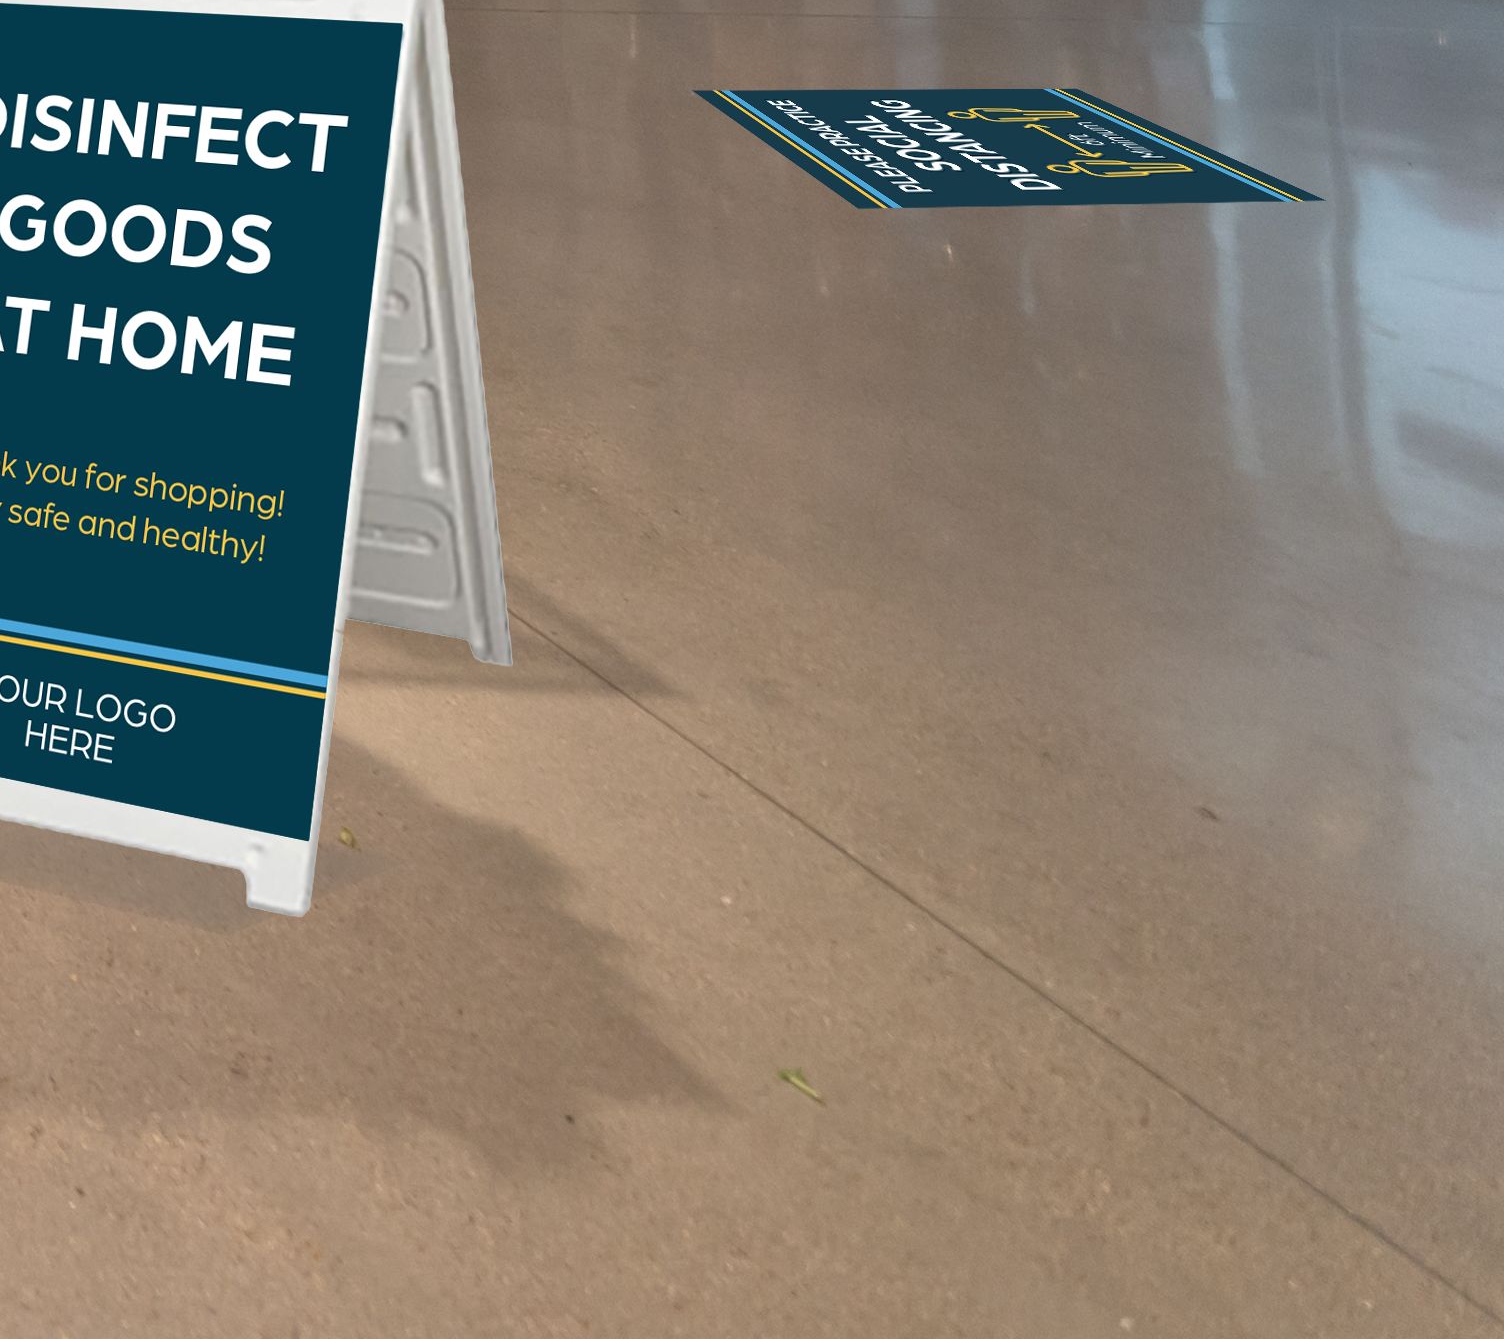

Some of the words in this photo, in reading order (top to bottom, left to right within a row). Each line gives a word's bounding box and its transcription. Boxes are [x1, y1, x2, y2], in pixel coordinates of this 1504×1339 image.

[845, 115, 963, 172] SOCIAL
[870, 98, 1063, 191] DISTANCING
[0, 194, 272, 274] GOODS
[67, 304, 295, 386] HOME
[26, 461, 77, 487] you
[86, 463, 126, 493] for
[134, 472, 284, 520] shopping!
[8, 502, 69, 531] safe
[79, 515, 136, 541] and
[143, 518, 265, 564] healthy!
[76, 689, 175, 732] LOGO
[25, 720, 115, 763] HERE
